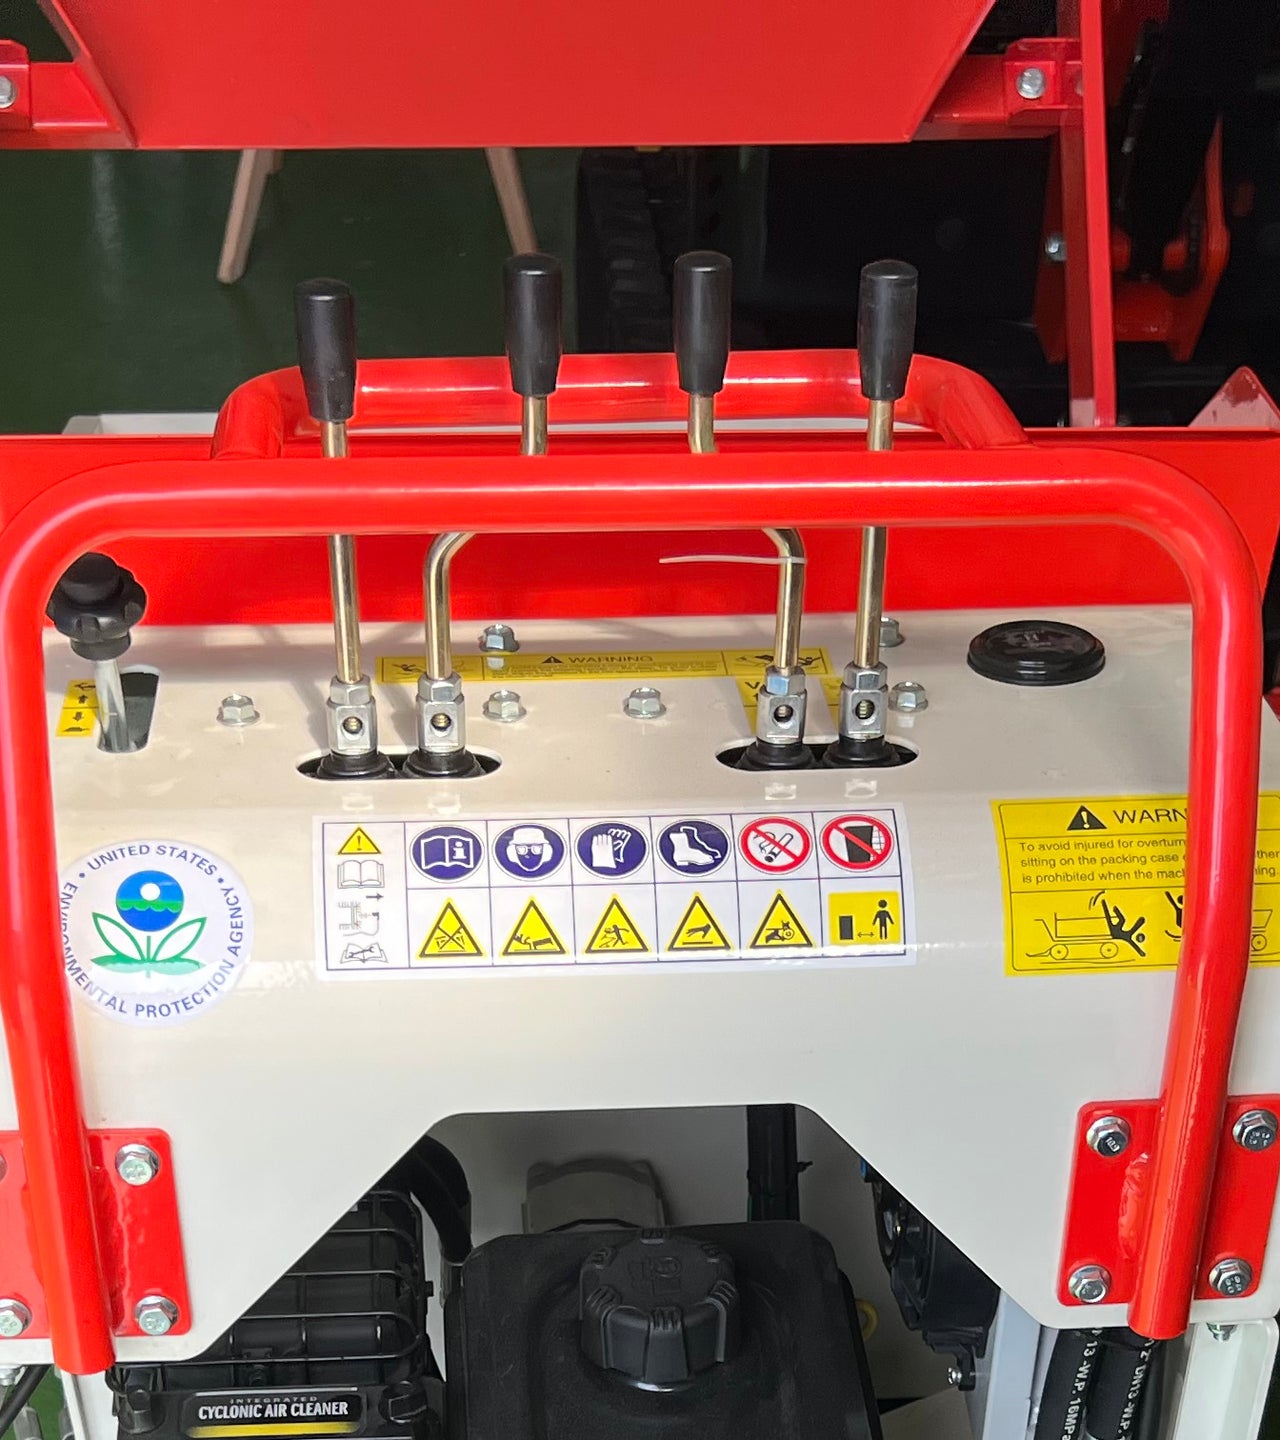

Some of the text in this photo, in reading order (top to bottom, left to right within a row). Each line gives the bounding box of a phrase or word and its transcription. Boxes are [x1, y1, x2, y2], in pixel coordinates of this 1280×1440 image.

[568, 655, 653, 664] WARNING
[1020, 842, 1035, 852] To
[1038, 841, 1070, 851] avoid
[1074, 839, 1114, 852] injured
[1117, 838, 1134, 848] for
[87, 844, 218, 876] UNITED STATES
[1020, 857, 1056, 868] sitting
[1059, 857, 1075, 866] on
[1078, 855, 1097, 865] the
[1101, 853, 1147, 866] packing
[1150, 854, 1179, 863] case
[1256, 849, 1280, 859] ther
[1023, 873, 1032, 883] is
[1036, 871, 1095, 885] prohibited
[1098, 870, 1131, 881] when
[1134, 869, 1153, 879] the
[135, 959, 234, 1018] PROTECTION
[220, 887, 244, 957] AGENCY
[230, 1396, 318, 1404] INTEGRATED
[198, 1402, 349, 1420] CYCLONIC AIR CLEANER
